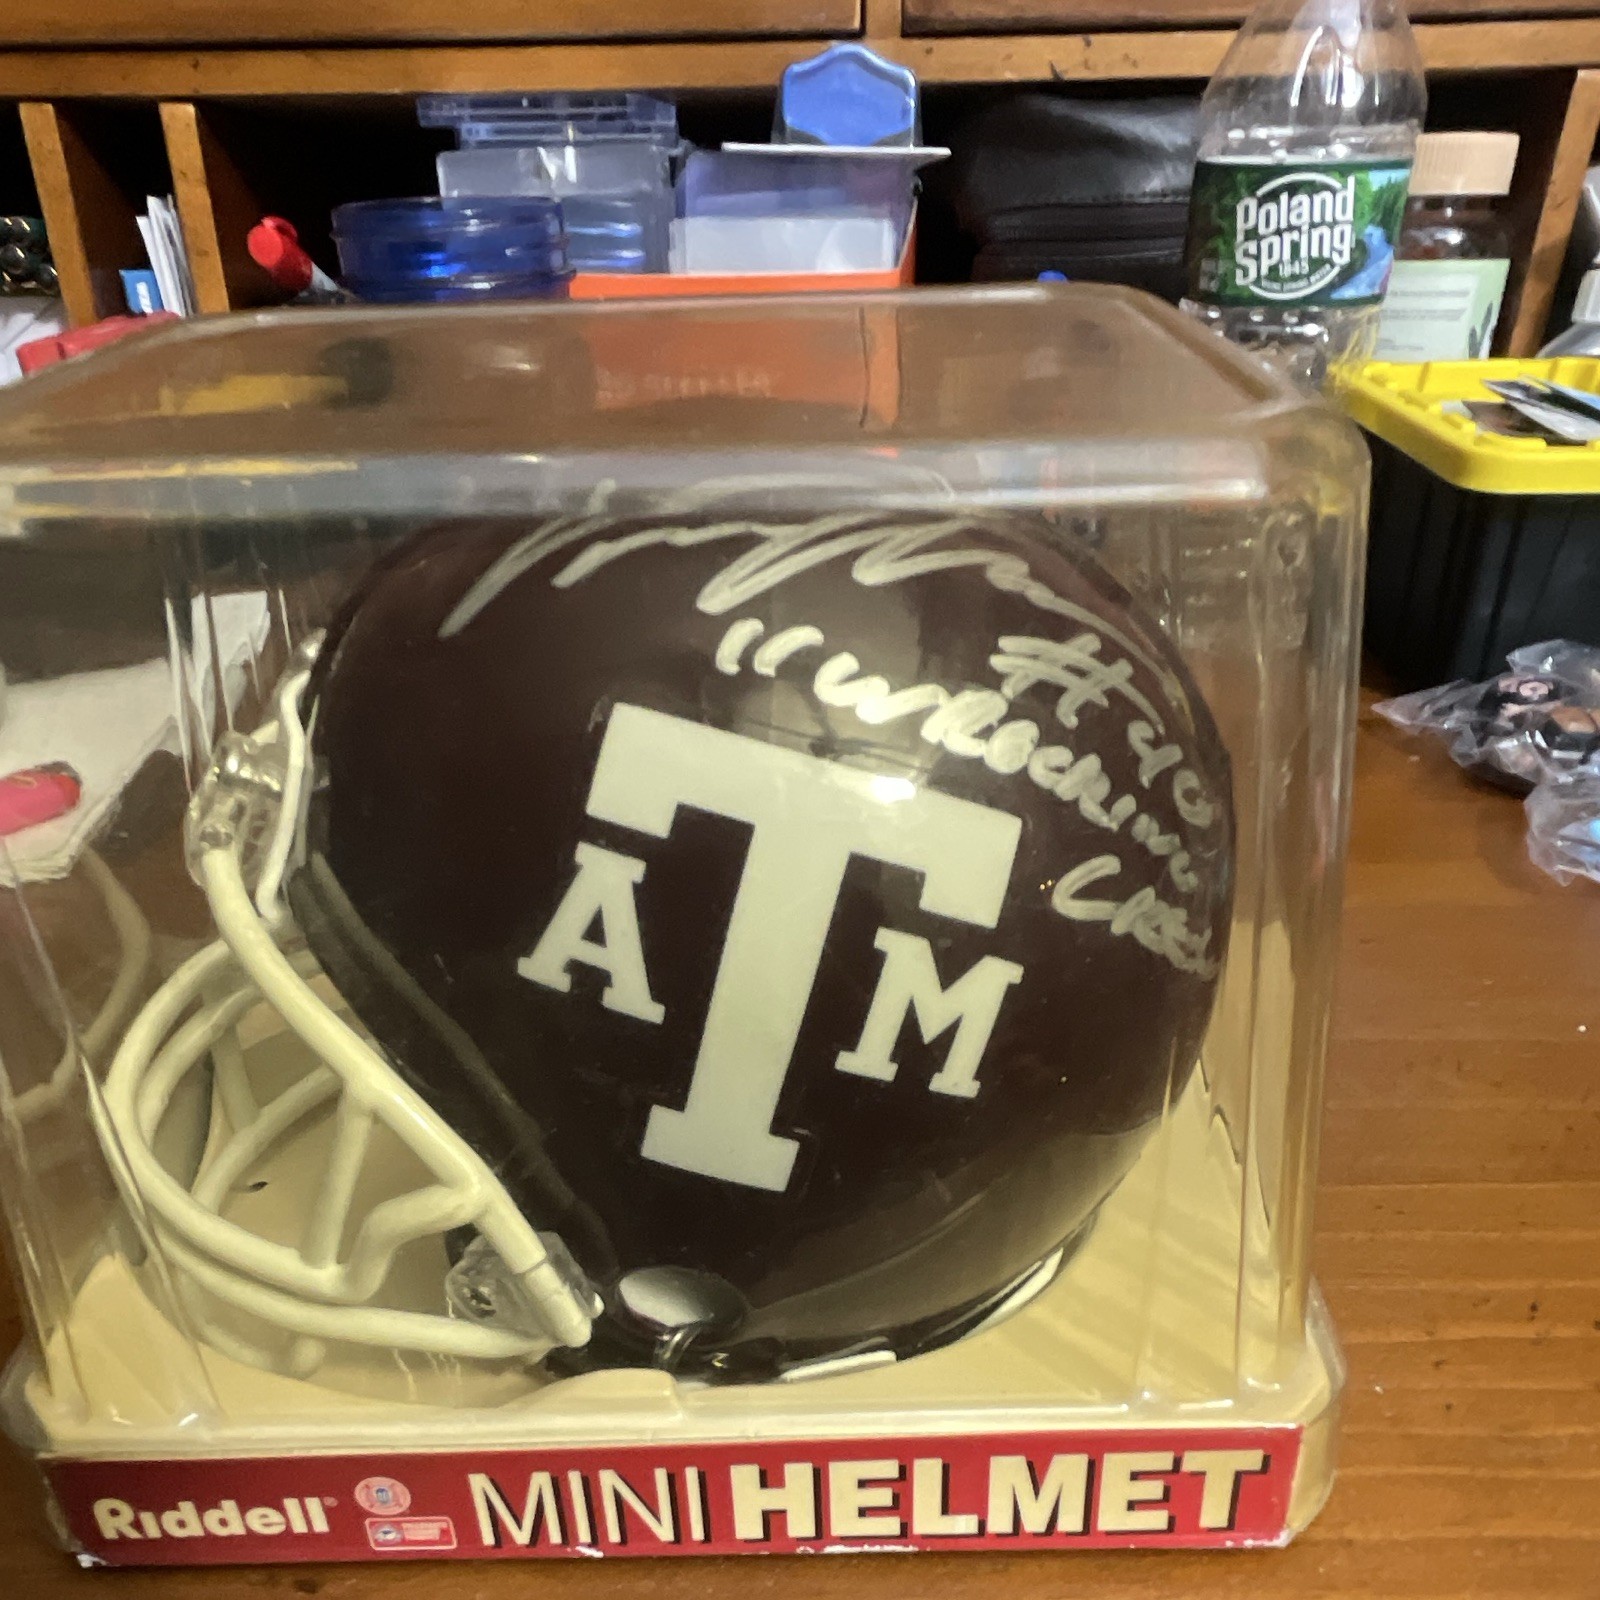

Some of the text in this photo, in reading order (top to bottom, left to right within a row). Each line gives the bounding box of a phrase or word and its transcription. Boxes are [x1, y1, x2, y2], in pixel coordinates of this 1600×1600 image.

[1236, 174, 1355, 243] Poland
[1234, 223, 1354, 286] Spring
[94, 1497, 330, 1540] Riddell
[467, 1466, 706, 1546] MINI
[730, 1449, 1266, 1540] HELMET
